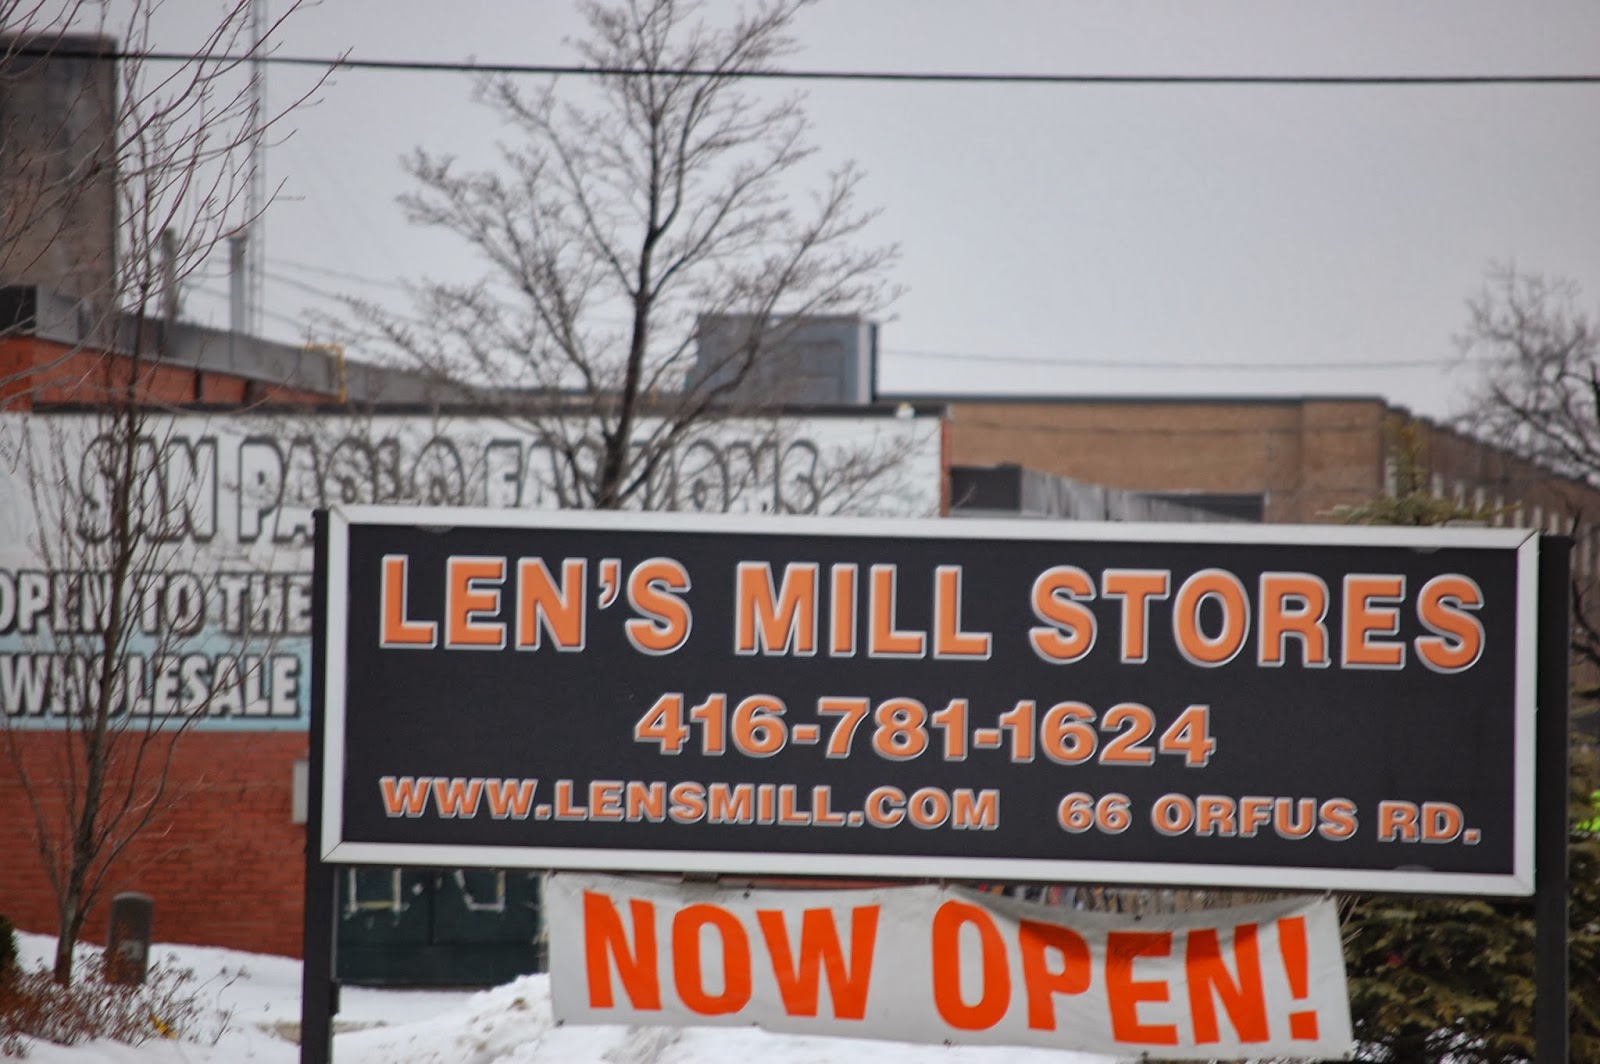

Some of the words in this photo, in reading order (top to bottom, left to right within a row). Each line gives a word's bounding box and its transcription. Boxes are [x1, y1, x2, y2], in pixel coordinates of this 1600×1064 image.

[131, 570, 206, 638] TO
[217, 571, 313, 638] THE
[378, 554, 693, 655] LEN'S
[734, 561, 993, 661] MILL
[1028, 565, 1486, 674] STORES
[0, 652, 301, 719] WHOLESALE
[633, 692, 1217, 768] 416-781-1624
[379, 776, 1000, 831] WWW.LENSMILL.COM
[1057, 792, 1132, 834] 66
[1151, 794, 1359, 841] ORFUS
[1377, 801, 1482, 845] RD.
[583, 889, 881, 1021] NOW
[932, 900, 1320, 1046] OPEN!
